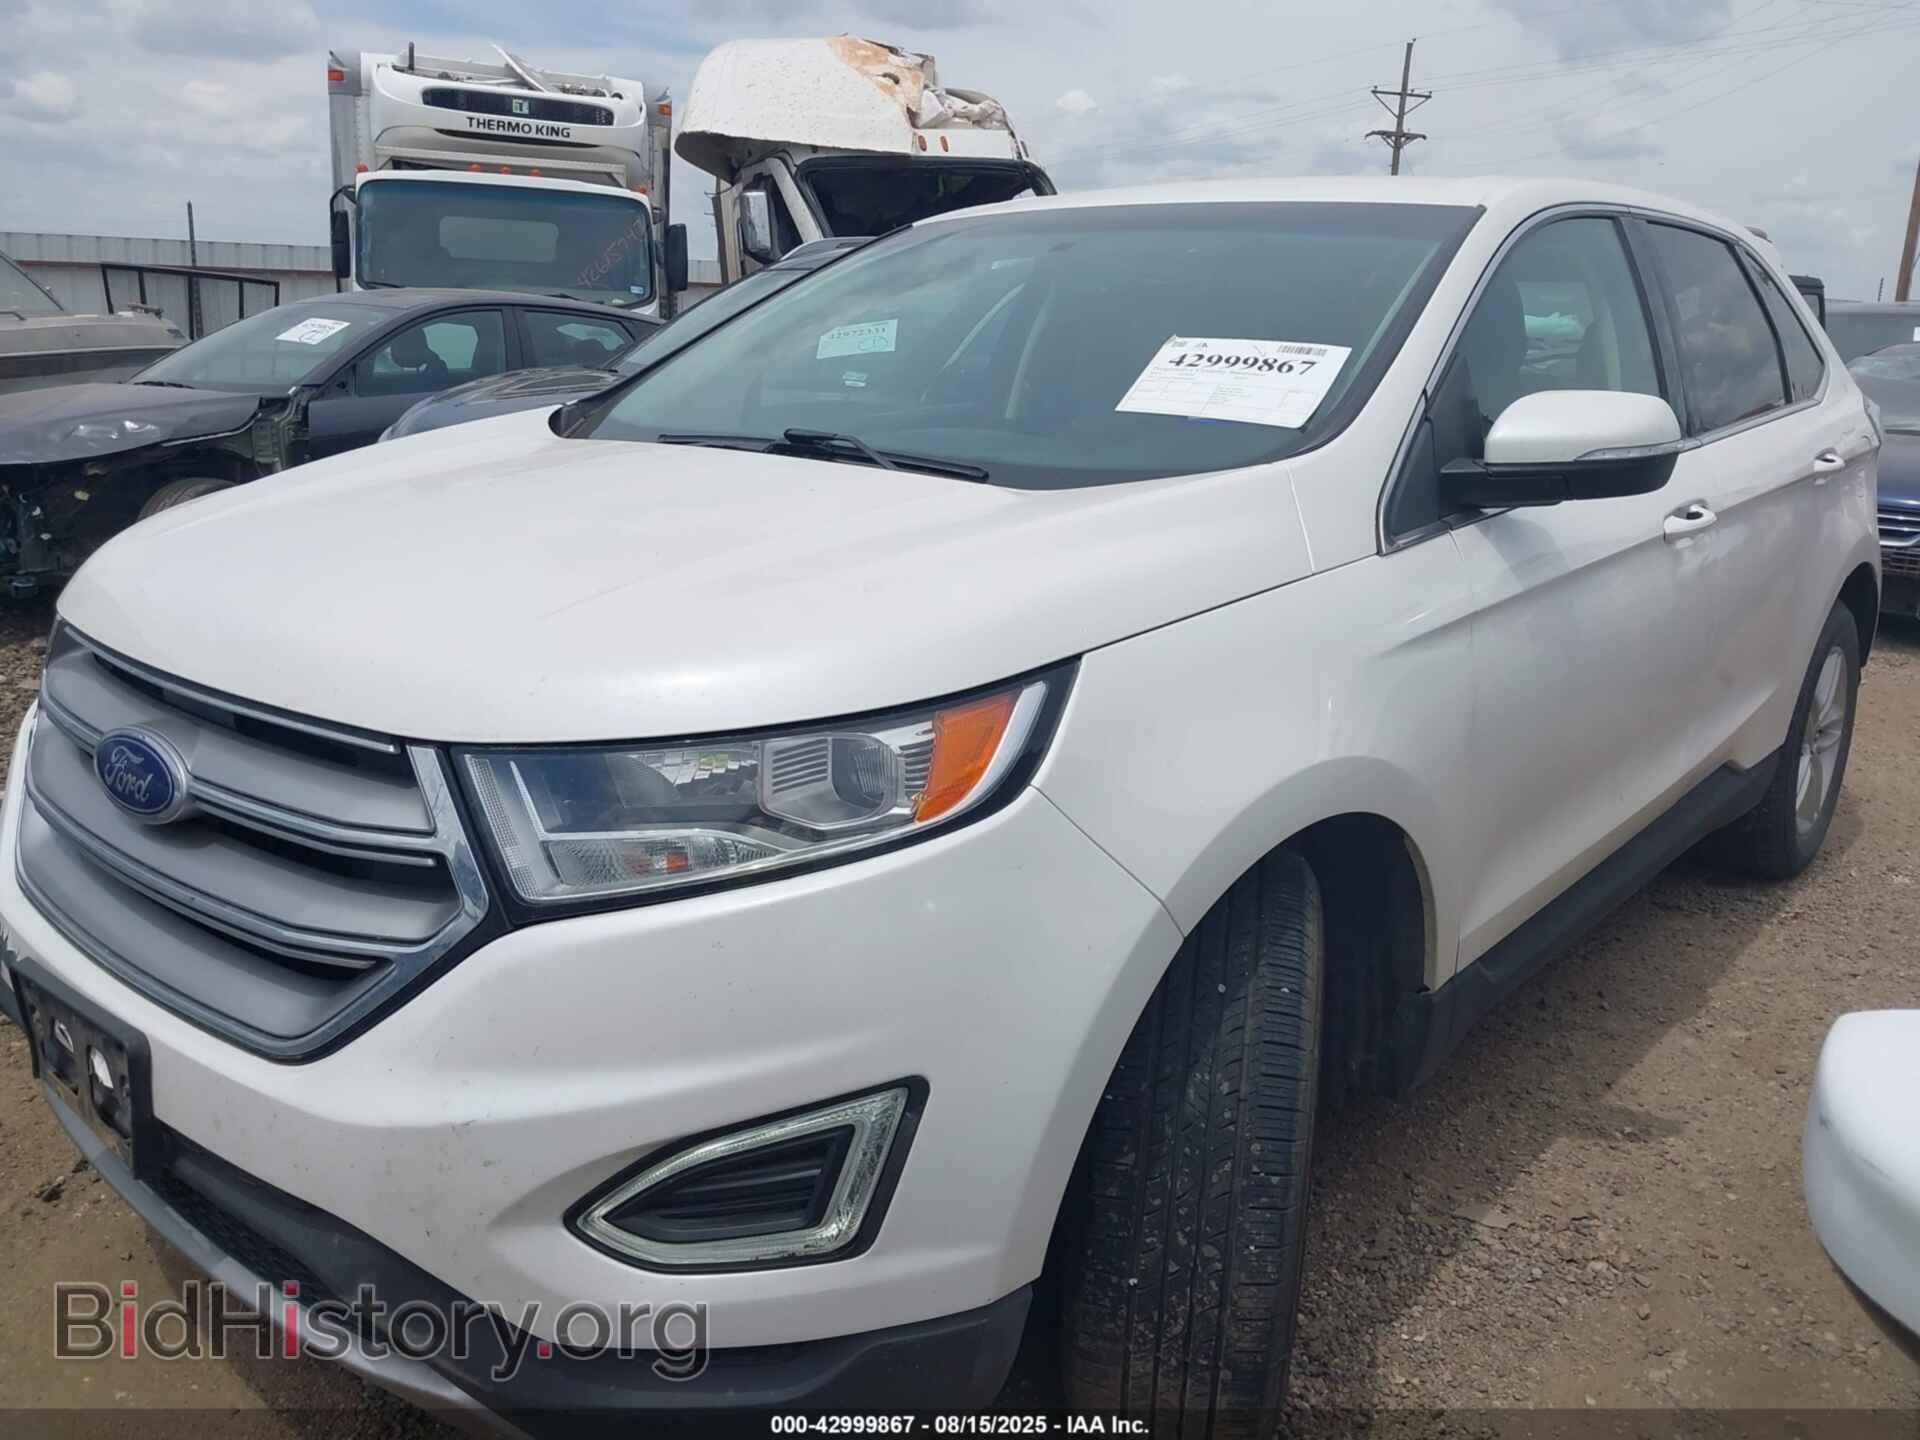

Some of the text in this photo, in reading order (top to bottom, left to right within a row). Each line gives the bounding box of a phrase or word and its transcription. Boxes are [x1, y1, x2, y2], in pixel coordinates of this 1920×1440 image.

[466, 116, 571, 139] THERMO KING
[1168, 352, 1320, 376] 42999867
[104, 745, 154, 803] Ford
